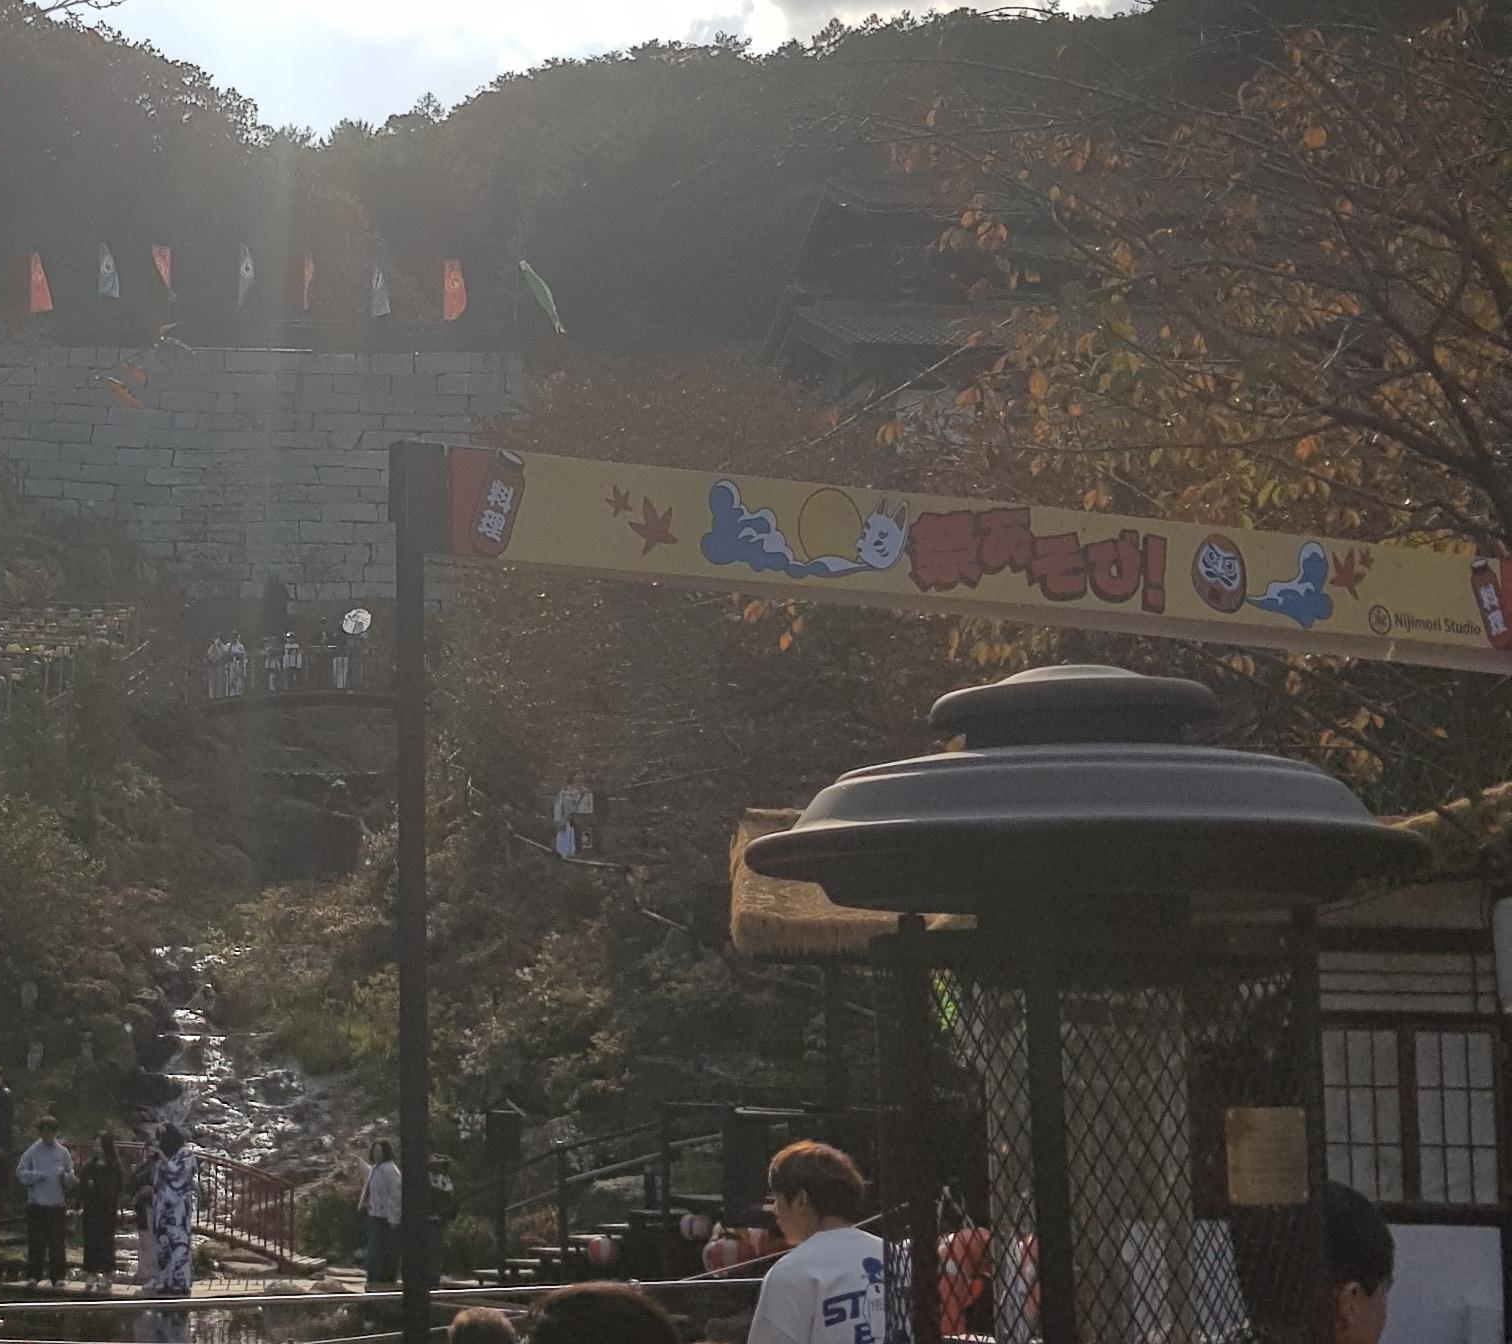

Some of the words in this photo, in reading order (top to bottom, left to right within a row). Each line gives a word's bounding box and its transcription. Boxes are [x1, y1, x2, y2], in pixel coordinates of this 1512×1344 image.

[478, 479, 514, 542] 料理
[1393, 612, 1441, 633] Nijimori
[1444, 617, 1481, 636] Studio
